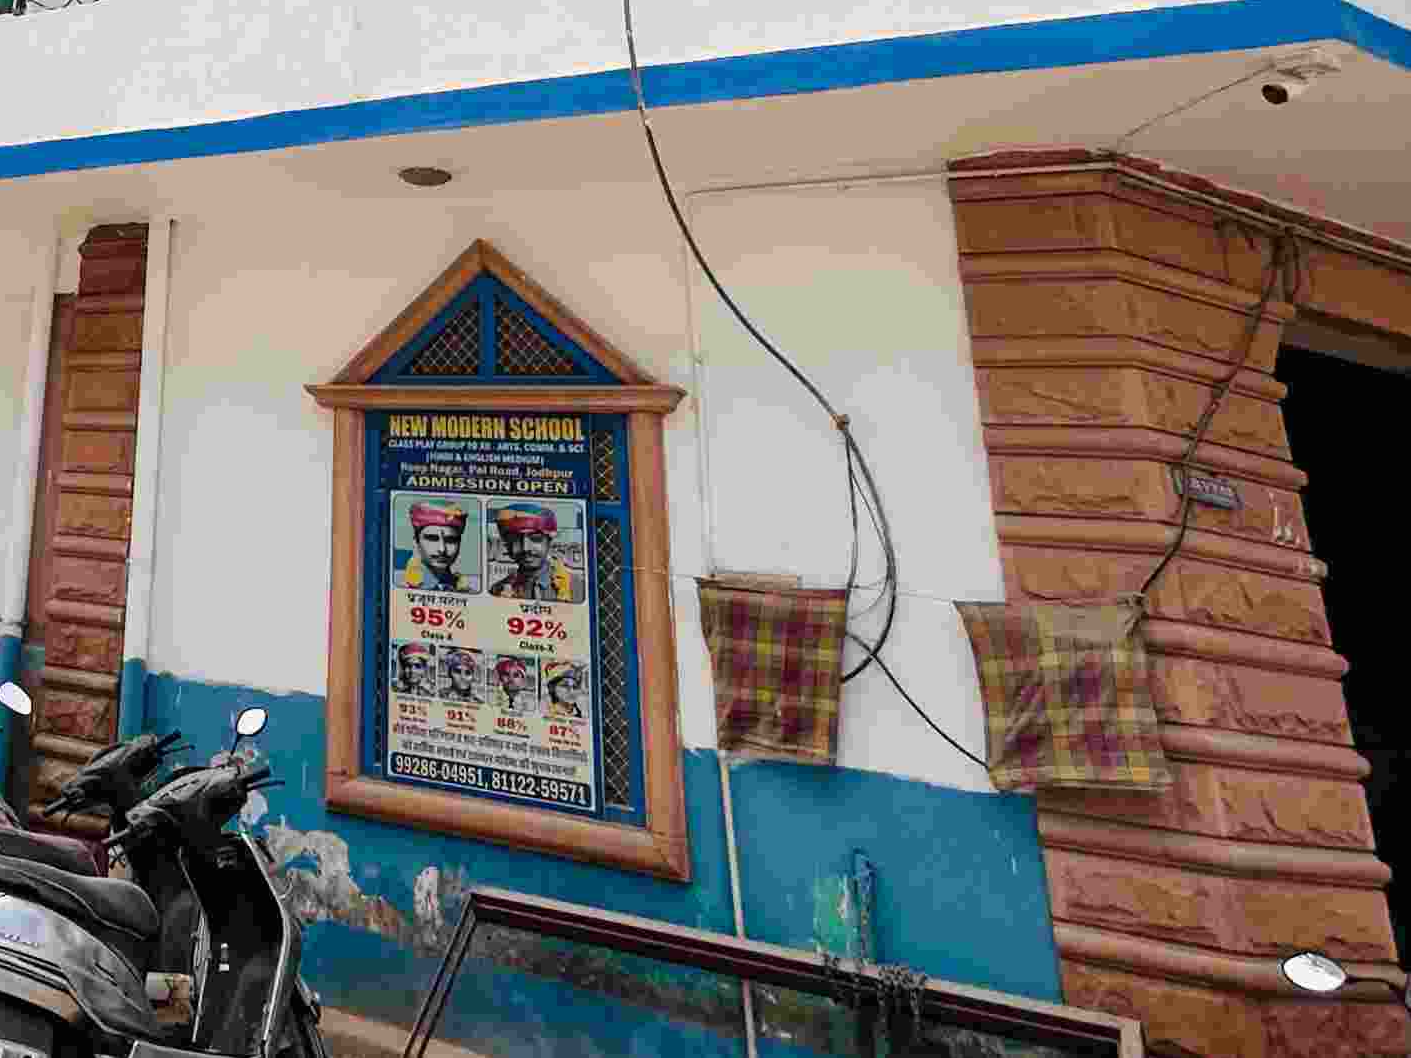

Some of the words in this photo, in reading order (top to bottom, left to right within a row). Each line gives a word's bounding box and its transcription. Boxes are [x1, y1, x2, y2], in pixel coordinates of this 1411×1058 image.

[388, 414, 428, 439] NEW
[431, 415, 506, 440] MODERN
[507, 416, 586, 442] SCHOOL
[525, 467, 574, 479] Jodhpur
[406, 476, 510, 491] ADMISSION
[516, 479, 568, 494] OPEN
[410, 607, 466, 630] 95%
[506, 617, 568, 641] 92%
[395, 754, 490, 790] 99286-04951,
[491, 771, 586, 805] 81122-59571
